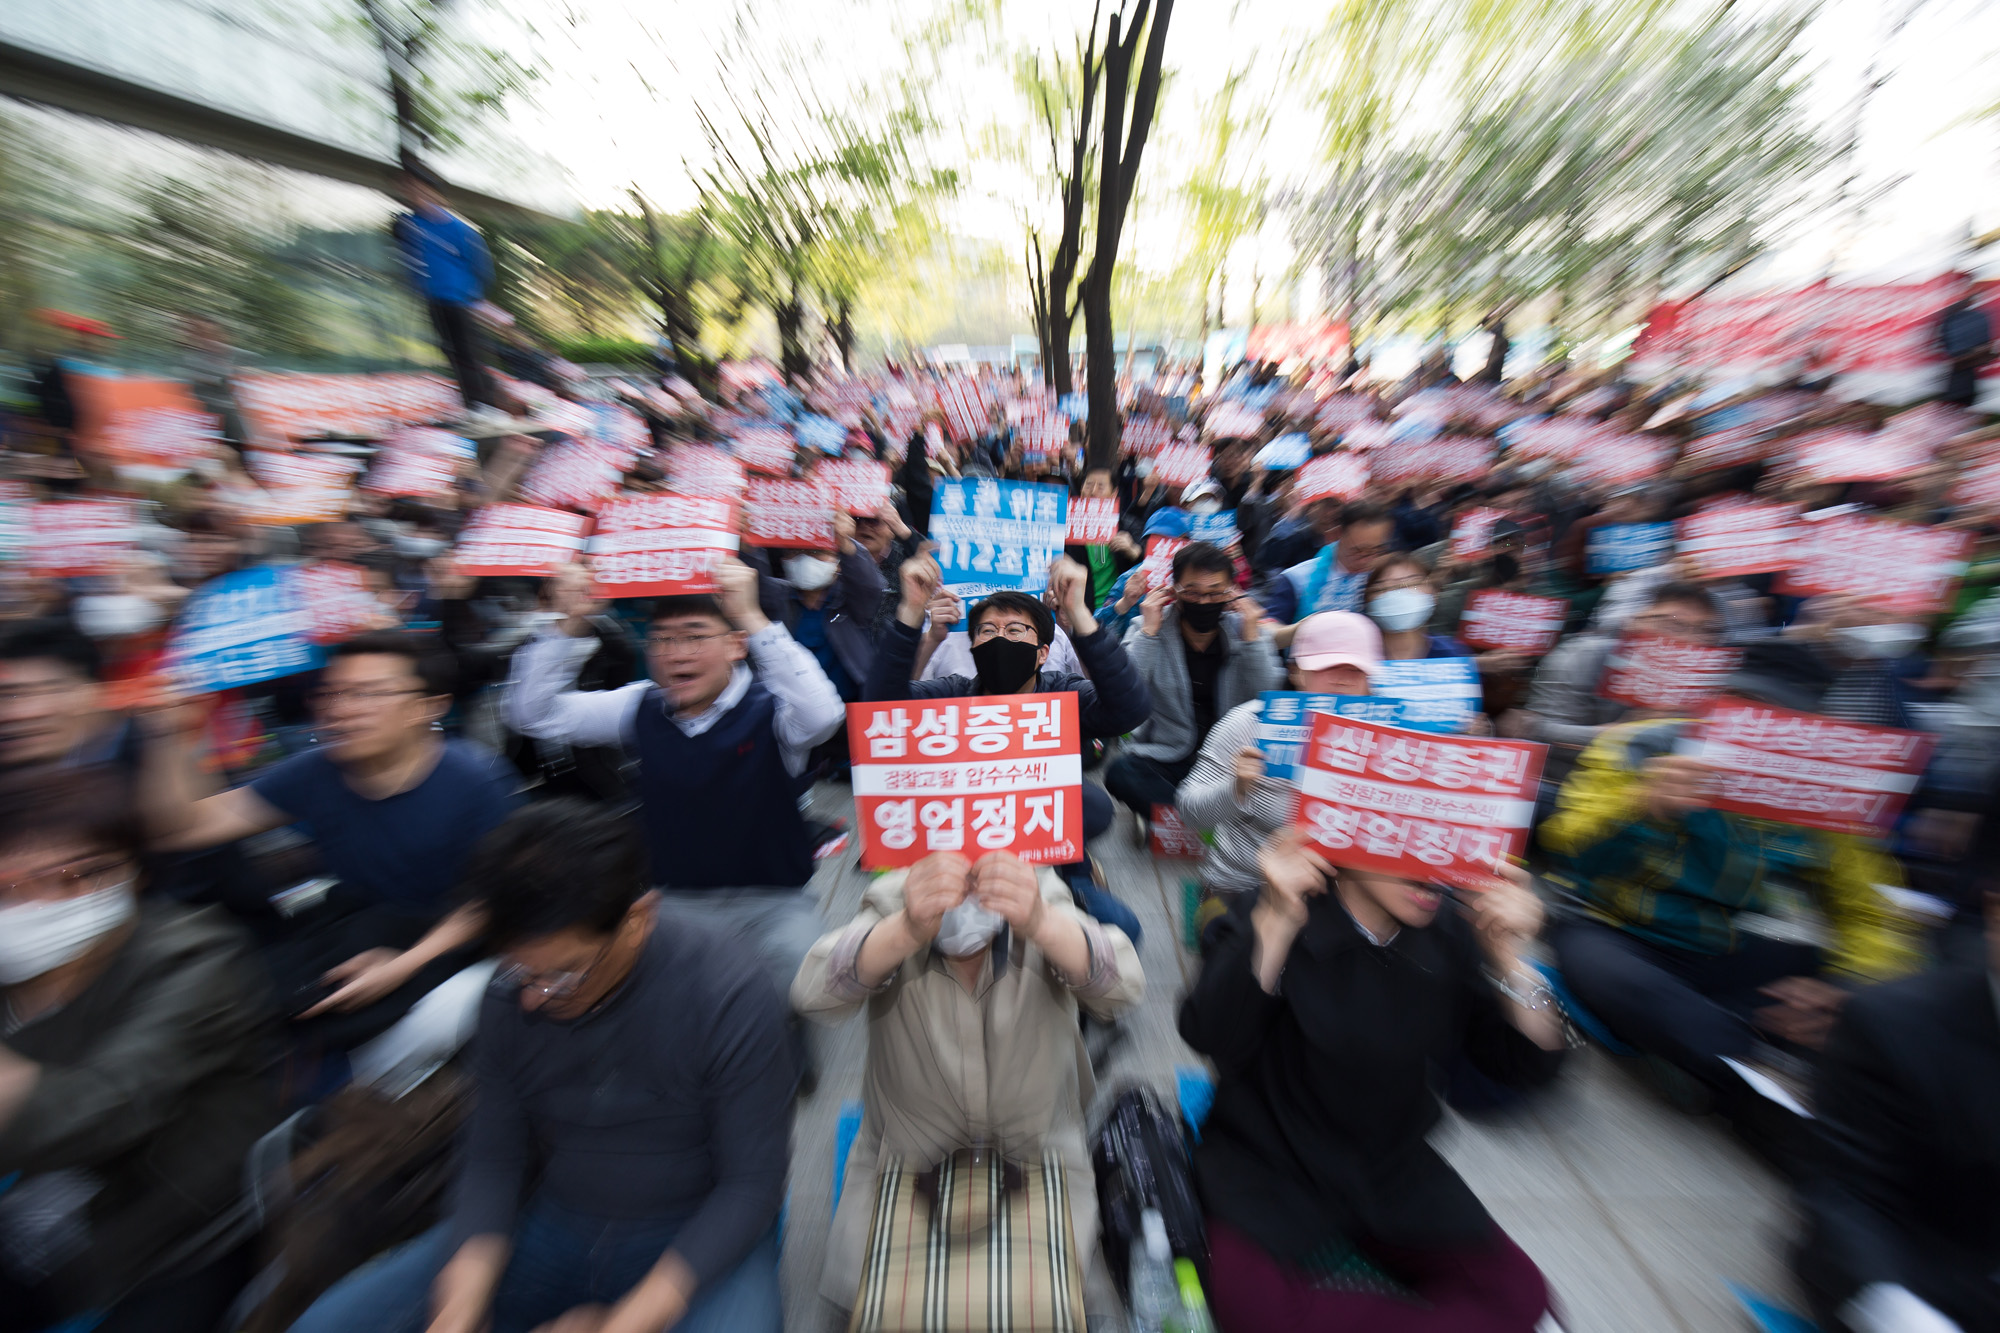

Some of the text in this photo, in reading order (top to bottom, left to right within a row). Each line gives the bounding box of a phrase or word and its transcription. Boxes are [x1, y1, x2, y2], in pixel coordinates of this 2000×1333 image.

[864, 699, 1061, 757] 삼성증권
[1722, 707, 1920, 767] 삼성증권
[965, 762, 1048, 787] 압수수색!
[1320, 724, 1531, 793] 삼성증권
[874, 790, 1064, 850] 영업정지
[1335, 780, 1504, 822] 검찰고발 압수수색!
[1309, 803, 1513, 875] 영업정지
